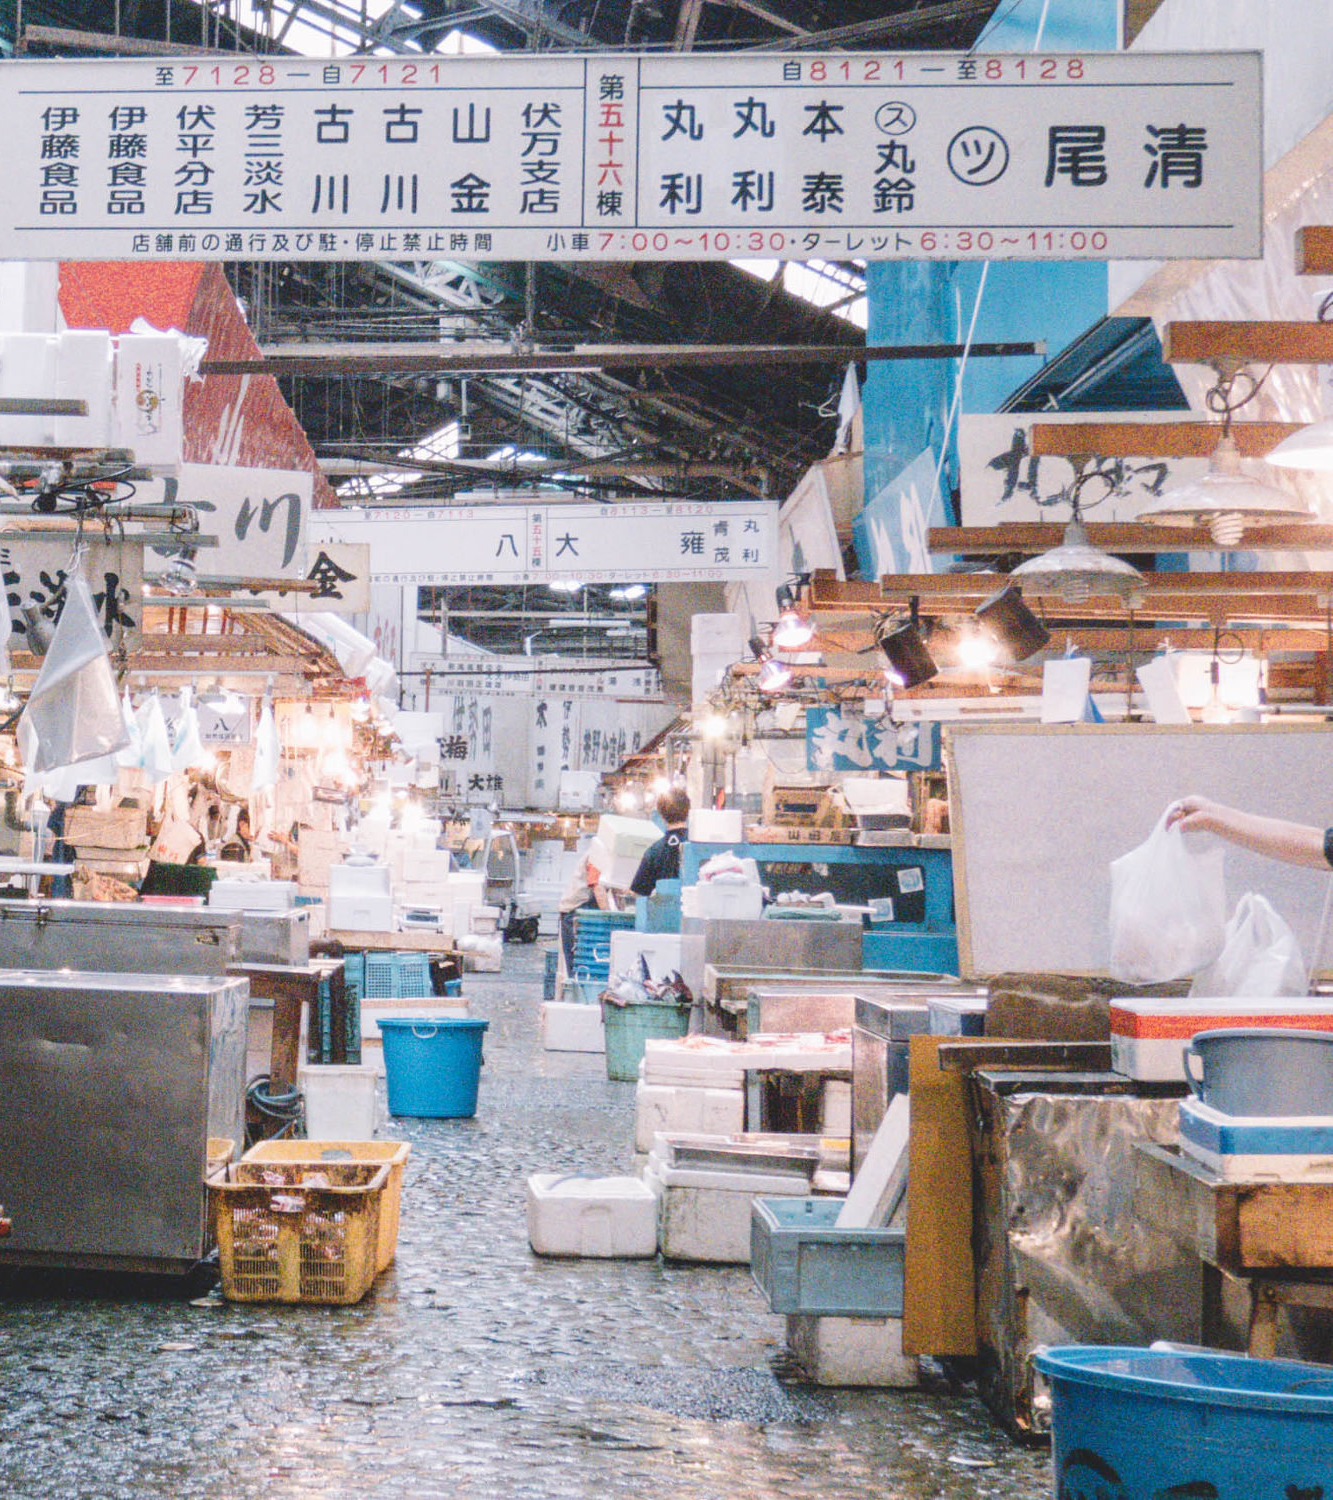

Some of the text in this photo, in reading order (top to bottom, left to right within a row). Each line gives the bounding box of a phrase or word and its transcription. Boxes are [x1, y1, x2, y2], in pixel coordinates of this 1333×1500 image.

[40, 105, 80, 215] 伊藤食品
[107, 105, 147, 215] 伊藤食品
[174, 105, 216, 215] 伏平分店
[244, 104, 284, 214] 芳三淡水
[312, 104, 353, 215] 古川
[381, 104, 424, 214] 古川
[450, 103, 491, 215] 山金
[519, 102, 562, 215] 伏万支店
[596, 74, 625, 218] 第五十六棟
[659, 100, 704, 215] 丸利
[731, 96, 775, 213] 丸利
[801, 100, 845, 214] 本泰
[495, 535, 519, 558] 八
[742, 519, 760, 562] 丸利
